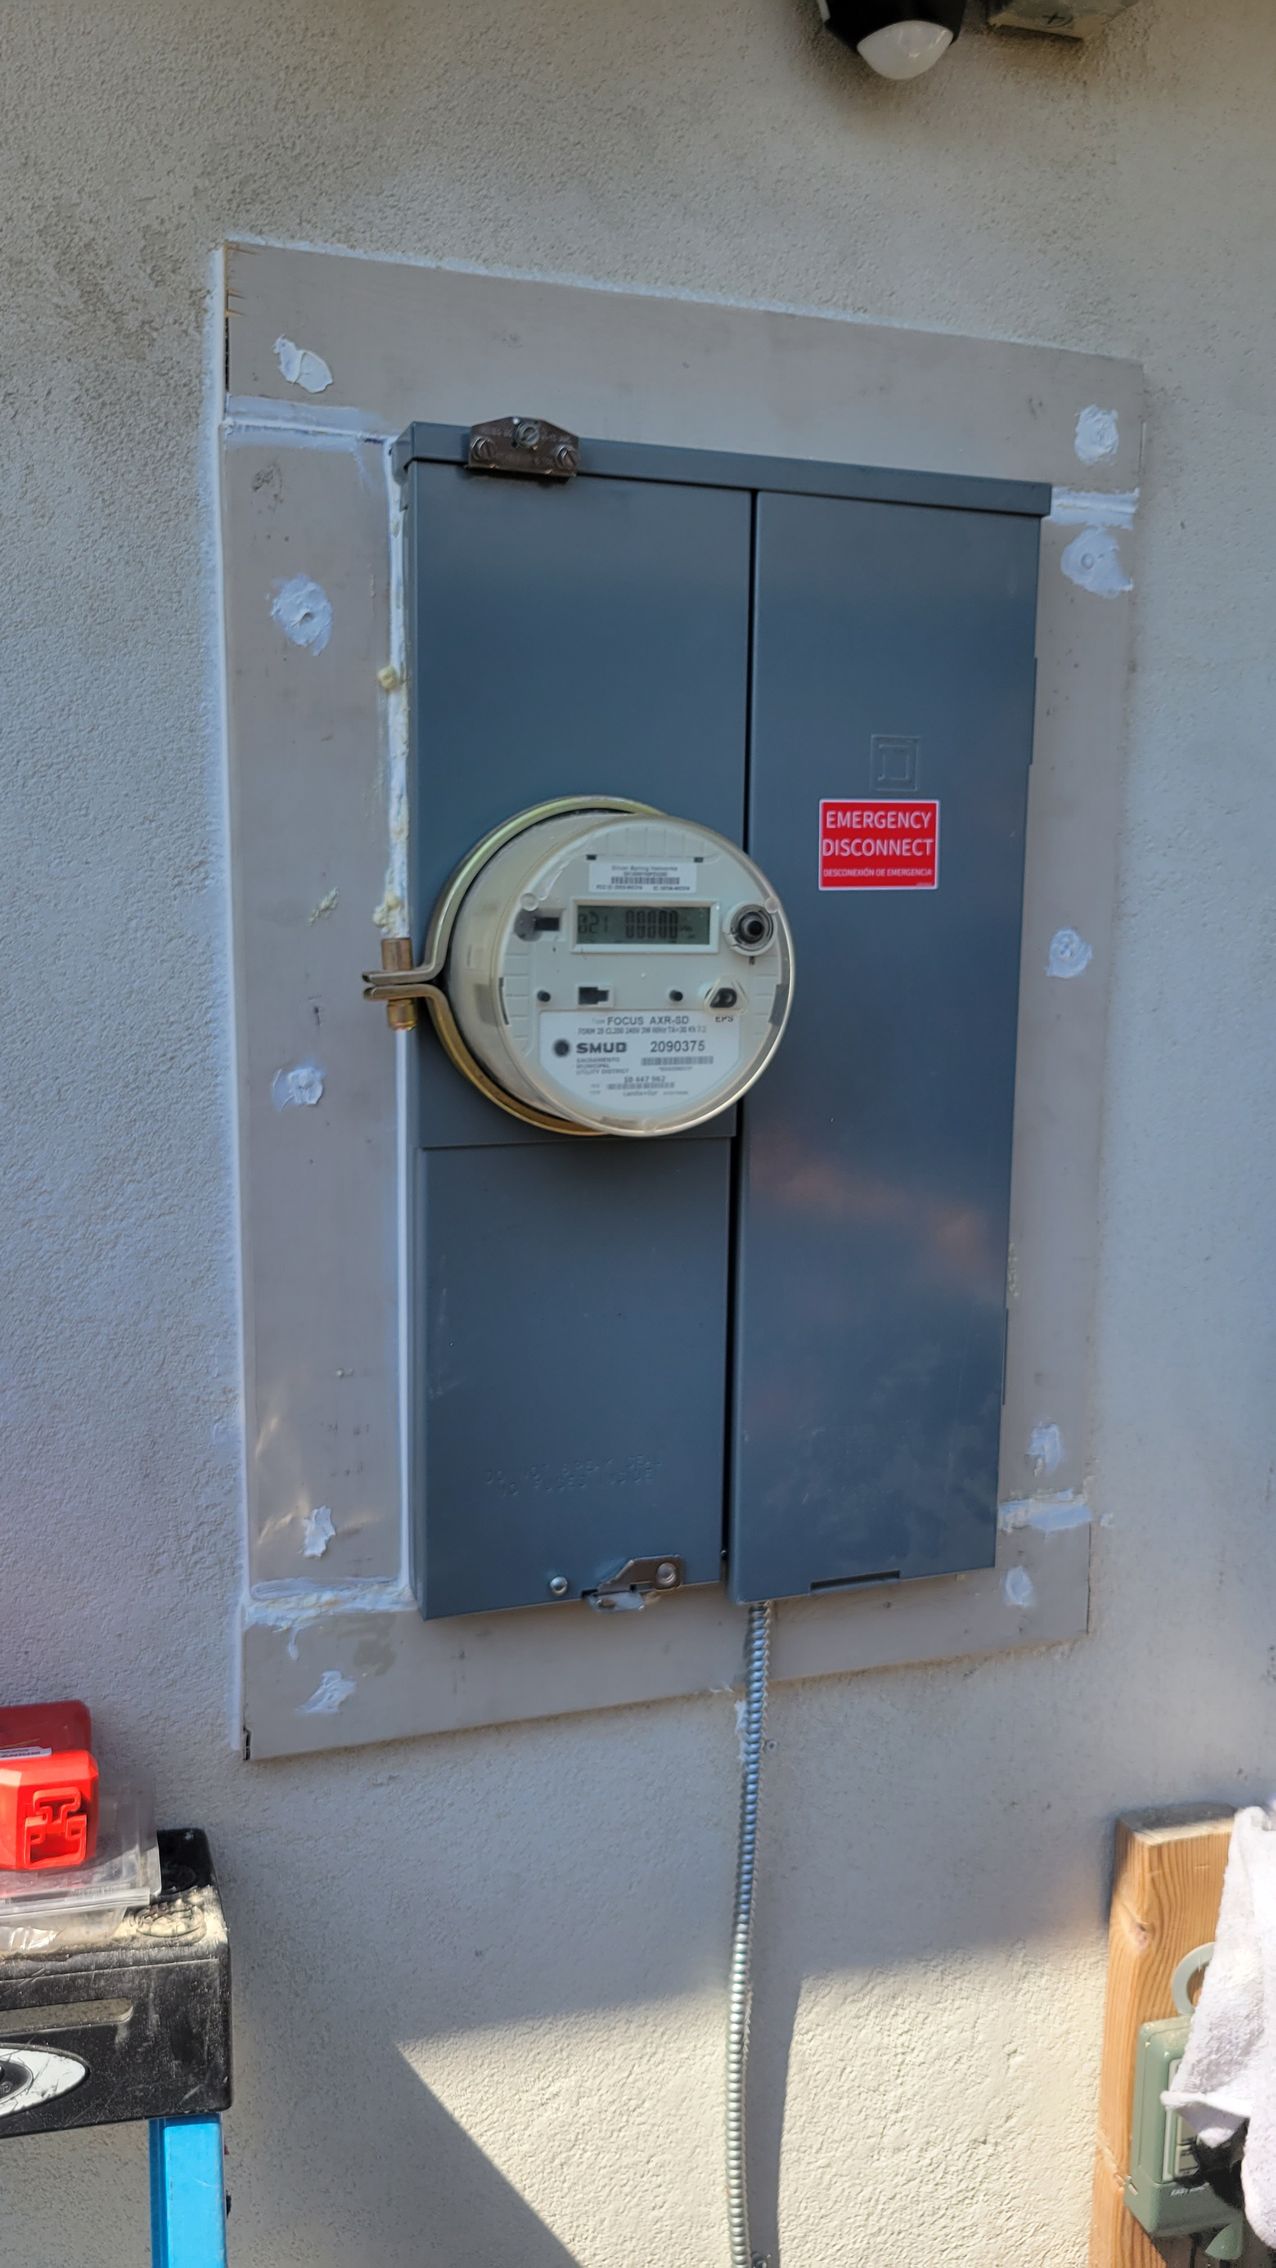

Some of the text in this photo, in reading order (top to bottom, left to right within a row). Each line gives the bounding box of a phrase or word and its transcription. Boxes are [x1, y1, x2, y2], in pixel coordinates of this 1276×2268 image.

[825, 810, 932, 829] EMERGENCY
[822, 838, 934, 857] DISCONNECT
[875, 868, 886, 878] DE
[886, 868, 932, 877] EMERGENCIA
[606, 1015, 645, 1025] FOCUS
[649, 1014, 690, 1025] AXR-SD
[576, 1039, 706, 1054] SMUD 2090375
